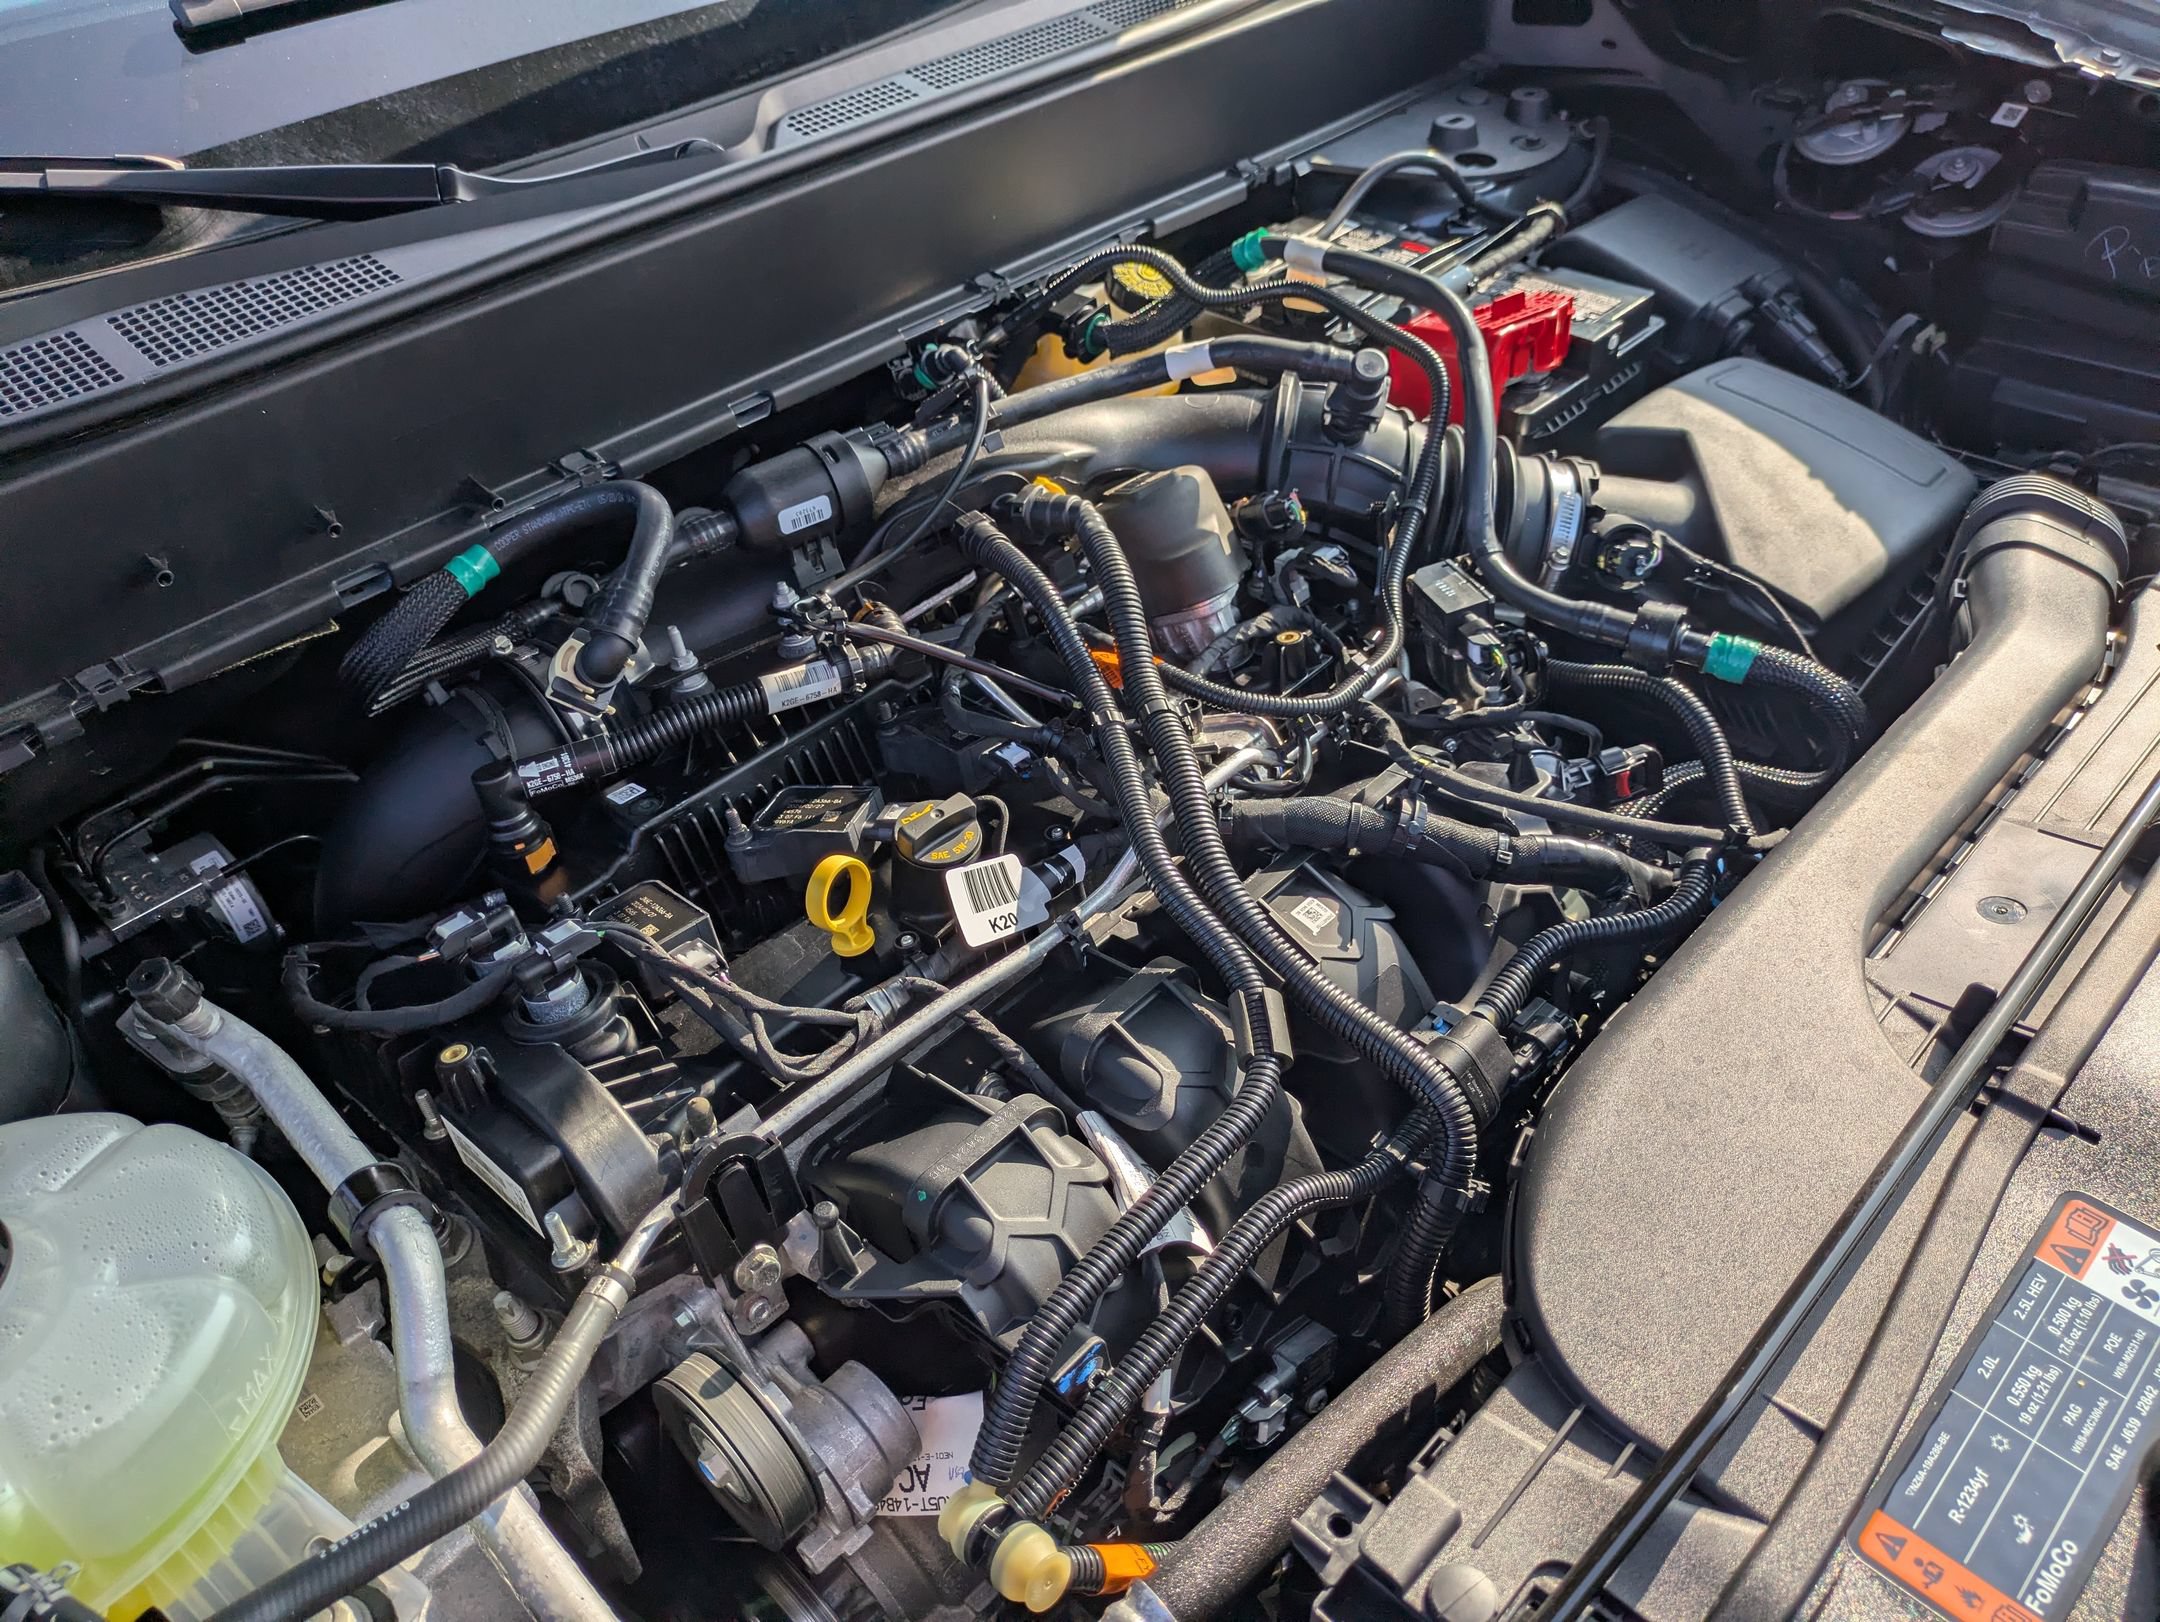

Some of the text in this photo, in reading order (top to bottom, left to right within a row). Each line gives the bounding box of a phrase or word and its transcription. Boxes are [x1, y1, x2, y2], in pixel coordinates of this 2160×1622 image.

[494, 530, 521, 552] COOPER
[781, 686, 838, 708] K2GE-6758-HA
[930, 830, 975, 860] SAE 5W-30
[2013, 1272, 2049, 1320] 2.5L HEV
[2047, 1296, 2083, 1336] 0.500 kg
[2057, 1292, 2104, 1356] 17.6 oz (1.10 lbs)
[2103, 1332, 2124, 1354] POE
[236, 1342, 274, 1415] MAX
[1977, 1355, 2000, 1380] 2.0L
[2006, 1364, 2043, 1407] 0.550 kg
[2018, 1364, 2063, 1425] 19 oz (1.21 lbs)
[2062, 1403, 2083, 1427] PAG
[2104, 1444, 2128, 1471] SAE
[2120, 1416, 2142, 1445] J639
[1948, 1466, 1990, 1524] R-1234yf
[2024, 1539, 2079, 1616] FoMoCo
